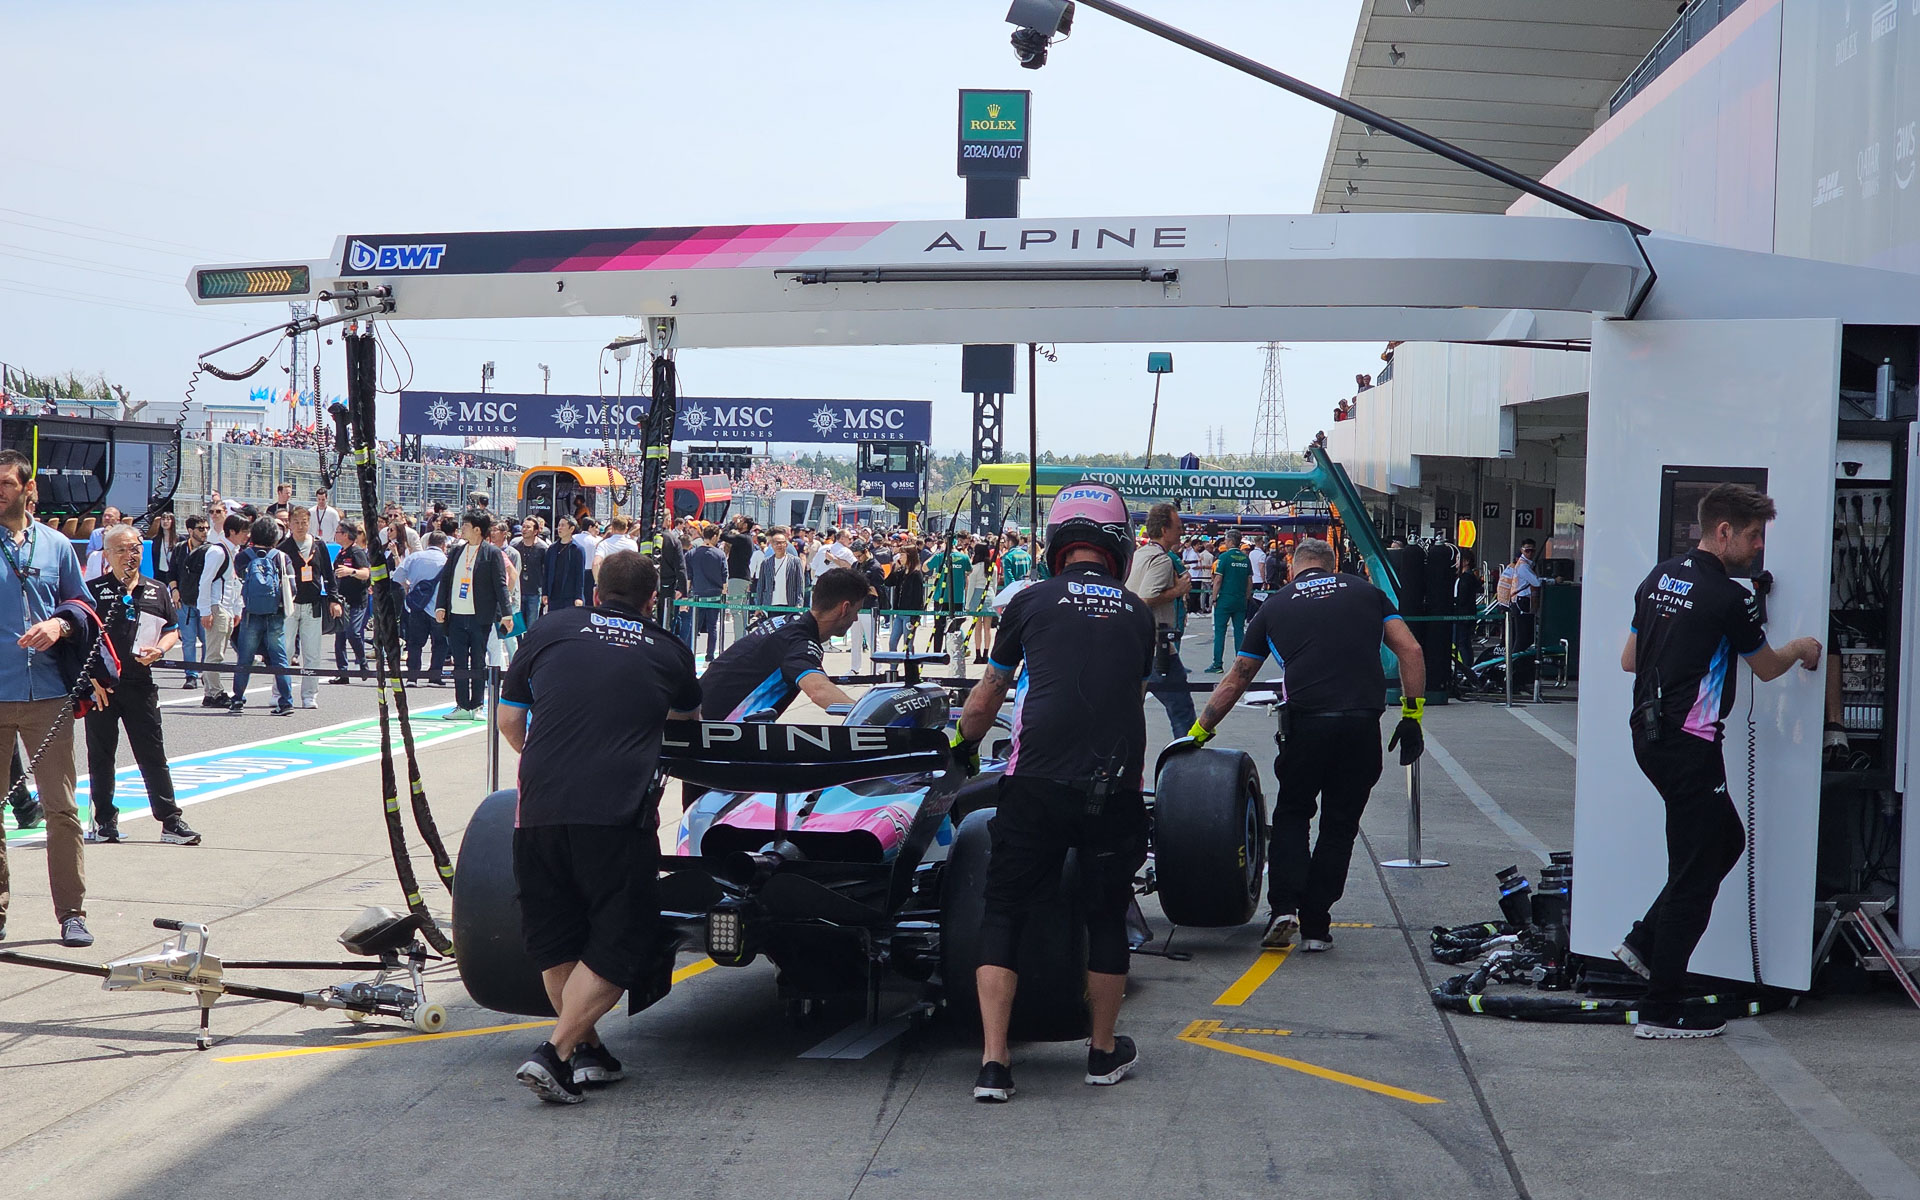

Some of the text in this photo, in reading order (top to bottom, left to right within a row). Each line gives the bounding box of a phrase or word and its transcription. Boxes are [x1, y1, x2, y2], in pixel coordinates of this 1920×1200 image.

[970, 120, 1017, 130] ROLEX
[963, 145, 1023, 159] 2024/04/07
[924, 226, 1188, 253] ALPINE
[375, 243, 447, 270] BWT
[458, 402, 518, 423] MSC
[585, 404, 644, 426] MSC
[712, 406, 774, 428] MSC
[842, 408, 905, 430] MSC
[458, 425, 518, 433] CRUISES
[712, 430, 774, 438] CRUISES
[842, 432, 905, 440] CRUISES
[1080, 472, 1256, 489] ASTON MARTIN aramco
[1073, 489, 1114, 503] BWT
[1437, 508, 1449, 520] 13
[1484, 504, 1499, 517] 17
[1517, 512, 1533, 526] 19
[1307, 576, 1337, 588] BWT
[1666, 577, 1694, 596] BWT
[1085, 583, 1123, 599] BWT
[1291, 582, 1348, 600] ALPINE
[1058, 596, 1134, 613] ALPINE
[1647, 591, 1694, 610] ALPINE
[1094, 606, 1118, 614] TEAM
[606, 616, 644, 634] BWT
[580, 626, 655, 645] ALPINE
[614, 636, 638, 646] TEAM
[661, 722, 889, 752] LPINE
